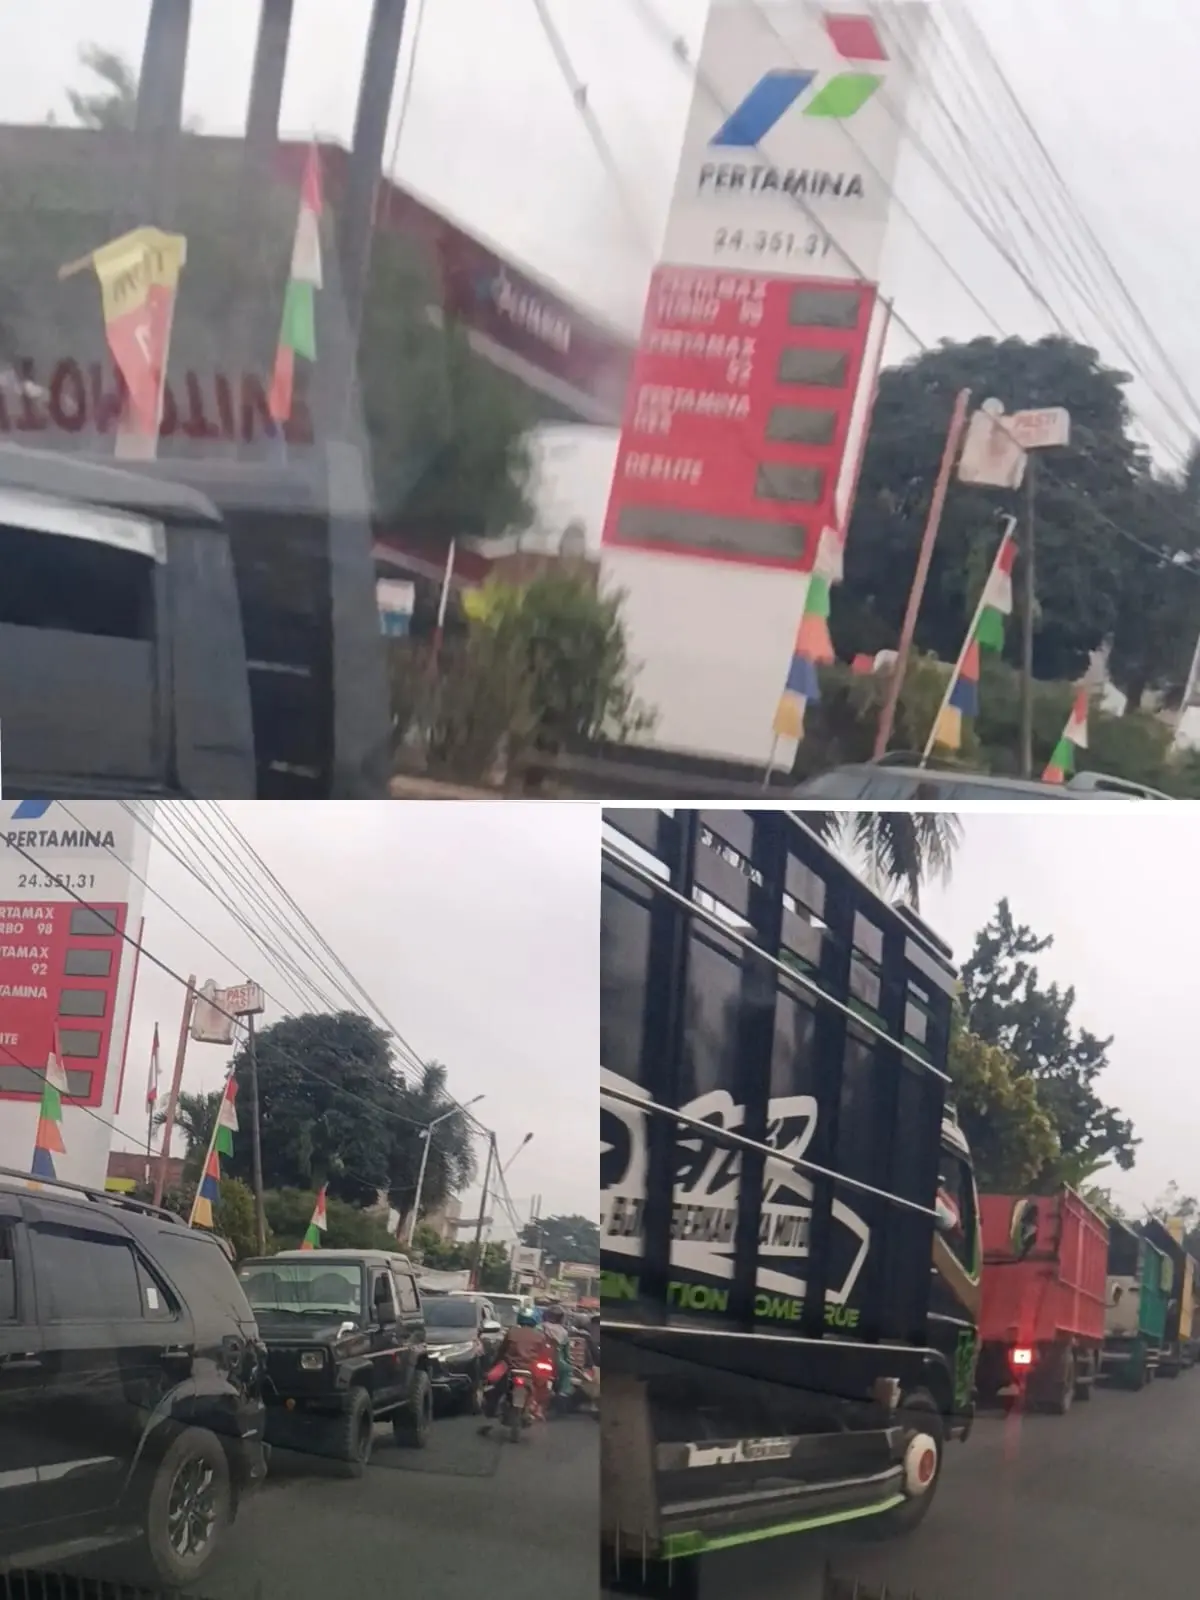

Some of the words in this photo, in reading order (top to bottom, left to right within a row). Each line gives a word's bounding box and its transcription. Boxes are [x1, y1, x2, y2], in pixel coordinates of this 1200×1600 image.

[699, 163, 864, 199] PERTAMINA
[6, 830, 115, 848] PERTAMINA
[18, 874, 95, 888] 24.351.31
[0, 946, 48, 959] TAMAX
[31, 964, 48, 975] 92
[0, 1033, 18, 1046] ITE
[823, 1303, 859, 1328] RUE
